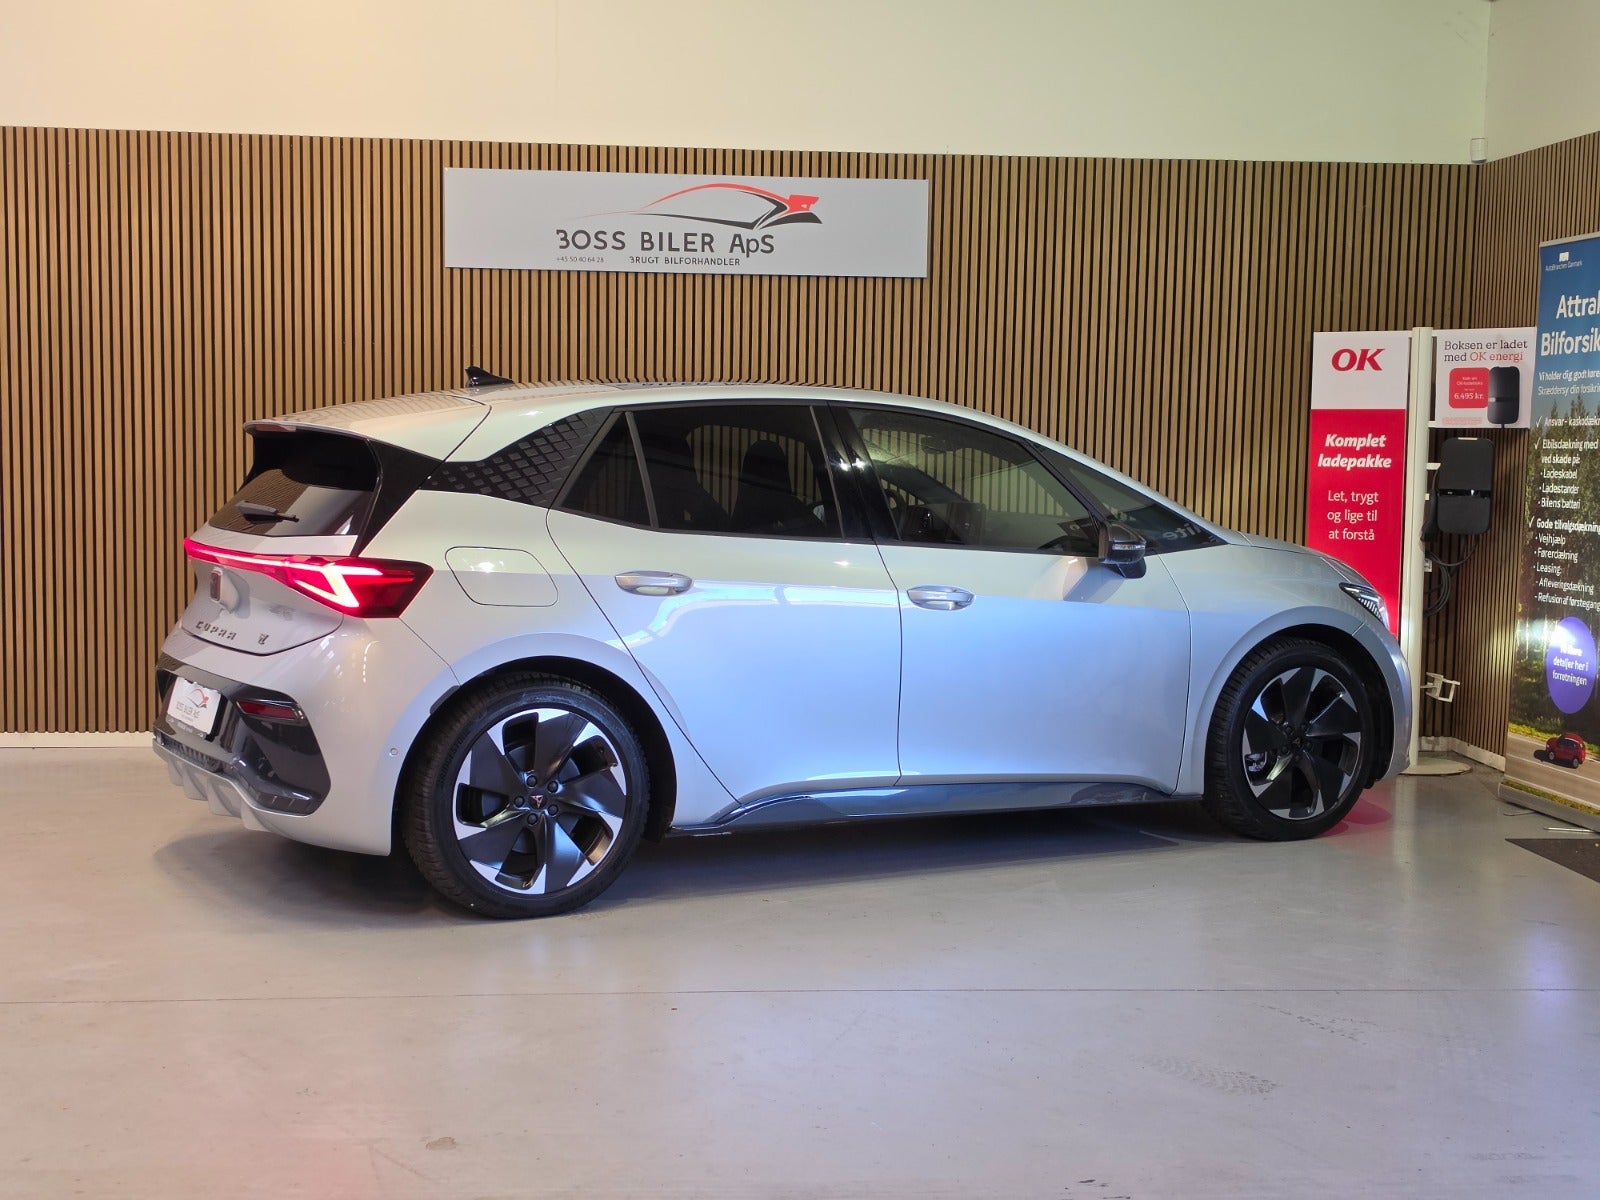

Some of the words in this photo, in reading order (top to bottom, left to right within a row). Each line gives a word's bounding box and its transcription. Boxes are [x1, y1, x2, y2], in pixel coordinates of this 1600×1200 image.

[641, 231, 714, 253] BILER
[729, 233, 775, 258] ApS
[664, 257, 740, 266] BILFORHANDLER
[1444, 340, 1483, 351] Boksen
[1486, 342, 1498, 350] er
[1500, 340, 1528, 349] ladet
[1541, 327, 1600, 356] Bilforsik
[1331, 348, 1386, 371] OK
[1444, 352, 1467, 362] med
[1469, 352, 1487, 362] OK
[1489, 352, 1523, 364] energi
[1562, 370, 1572, 381] dig
[1325, 433, 1387, 451] Komplet
[1584, 439, 1599, 451] med
[1318, 453, 1392, 471] ladepakke
[1553, 454, 1572, 464] skade
[1543, 468, 1578, 479] Ladeskabel
[1542, 483, 1580, 494] Ladestander
[1328, 490, 1348, 503] Let,
[1351, 491, 1379, 505] trygt
[1327, 512, 1341, 524] og
[1344, 509, 1364, 524] lige
[1367, 509, 1378, 522] til
[1537, 519, 1554, 529] Gode
[1328, 529, 1340, 540] at
[1342, 528, 1375, 541] forstå
[1538, 547, 1579, 564] Førerdækning
[196, 621, 237, 641] CUPRA
[1575, 660, 1586, 671] her
